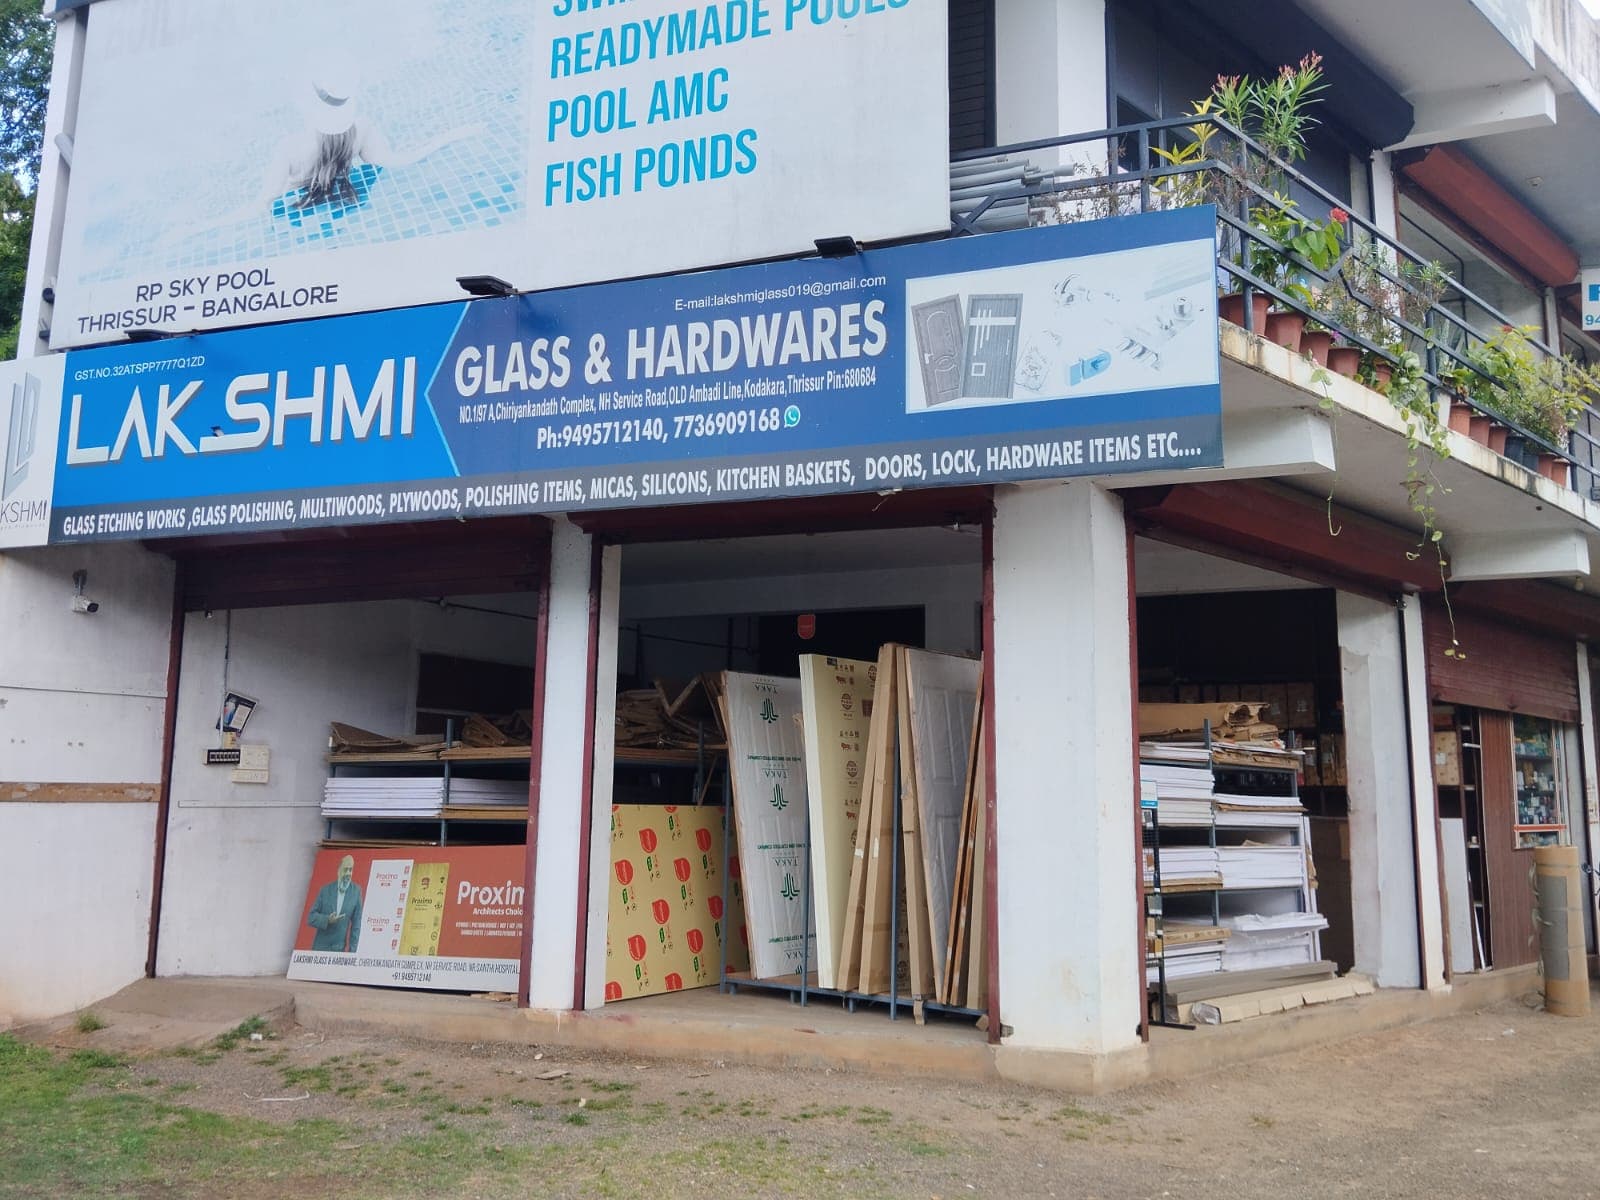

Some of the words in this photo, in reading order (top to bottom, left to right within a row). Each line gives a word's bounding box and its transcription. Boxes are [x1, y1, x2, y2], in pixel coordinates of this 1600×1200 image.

[550, 0, 772, 79] READYMADE
[547, 87, 637, 142] POOL
[647, 67, 729, 124] AMC
[544, 152, 621, 207] FISH
[634, 128, 758, 192] PONDS
[78, 304, 177, 334] THRISSUR
[202, 284, 339, 318] BANGALORE
[136, 283, 162, 302] RP
[169, 276, 210, 298] SKY
[216, 268, 276, 292] POOL
[454, 335, 571, 398] GLASS
[584, 332, 612, 385] &
[626, 299, 888, 380] HARDWARES
[560, 396, 597, 418] Complex,
[598, 392, 611, 410] NH
[613, 391, 643, 410] Service
[689, 381, 721, 403] Ambadi
[673, 407, 780, 439] 7736909168
[63, 514, 96, 536] GLASS
[97, 511, 144, 533] ETCHING
[147, 508, 186, 530] WORKS
[229, 499, 297, 524] POLISHING,
[299, 494, 386, 519] MULTIWOODS,
[390, 488, 462, 513] PLYWOODS,
[465, 482, 539, 508] POLISHING
[543, 478, 587, 505] ITEMS,
[590, 475, 638, 501] MICAS,
[641, 470, 713, 496] SILICONS,
[716, 465, 780, 491] KITCHEN
[785, 459, 856, 486] BASKETS,
[865, 452, 927, 481] DOORS,
[932, 449, 982, 476] LOCK,
[986, 439, 1083, 471] HARDWARE
[1089, 434, 1141, 464] ITEMS
